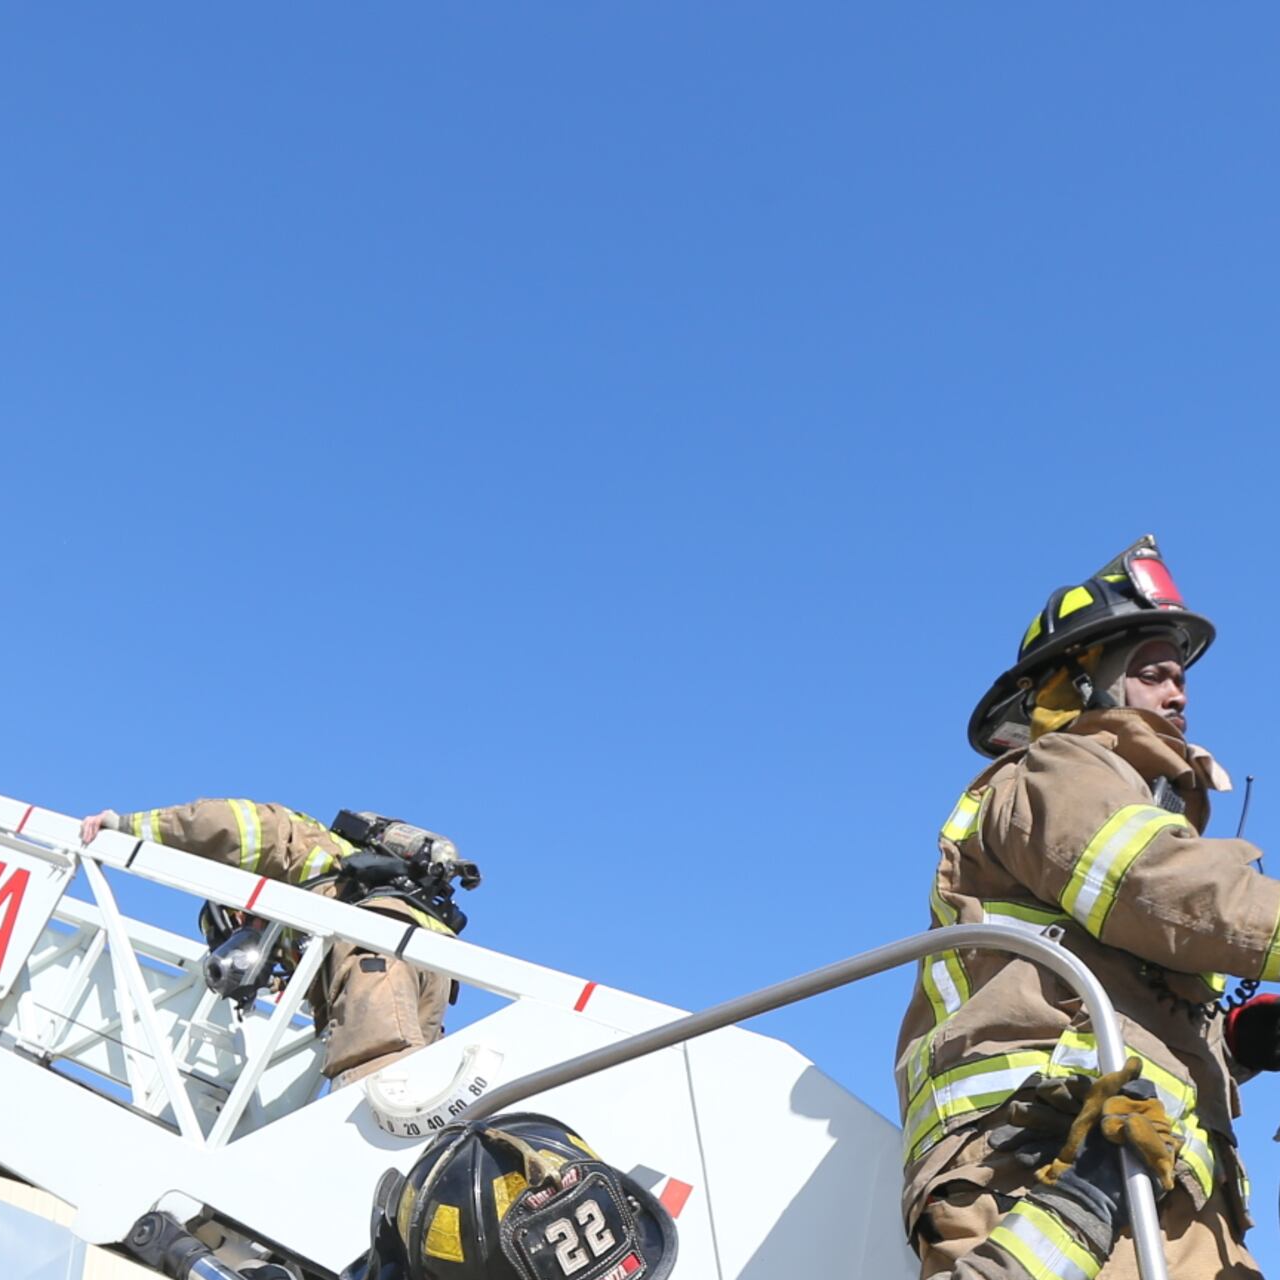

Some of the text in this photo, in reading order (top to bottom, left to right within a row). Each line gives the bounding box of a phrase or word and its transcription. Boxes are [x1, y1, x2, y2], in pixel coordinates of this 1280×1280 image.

[403, 1122, 421, 1136] 20
[426, 1114, 446, 1131] 40
[447, 1098, 468, 1117] 60
[468, 1076, 488, 1097] 80
[544, 1199, 616, 1277] 22
